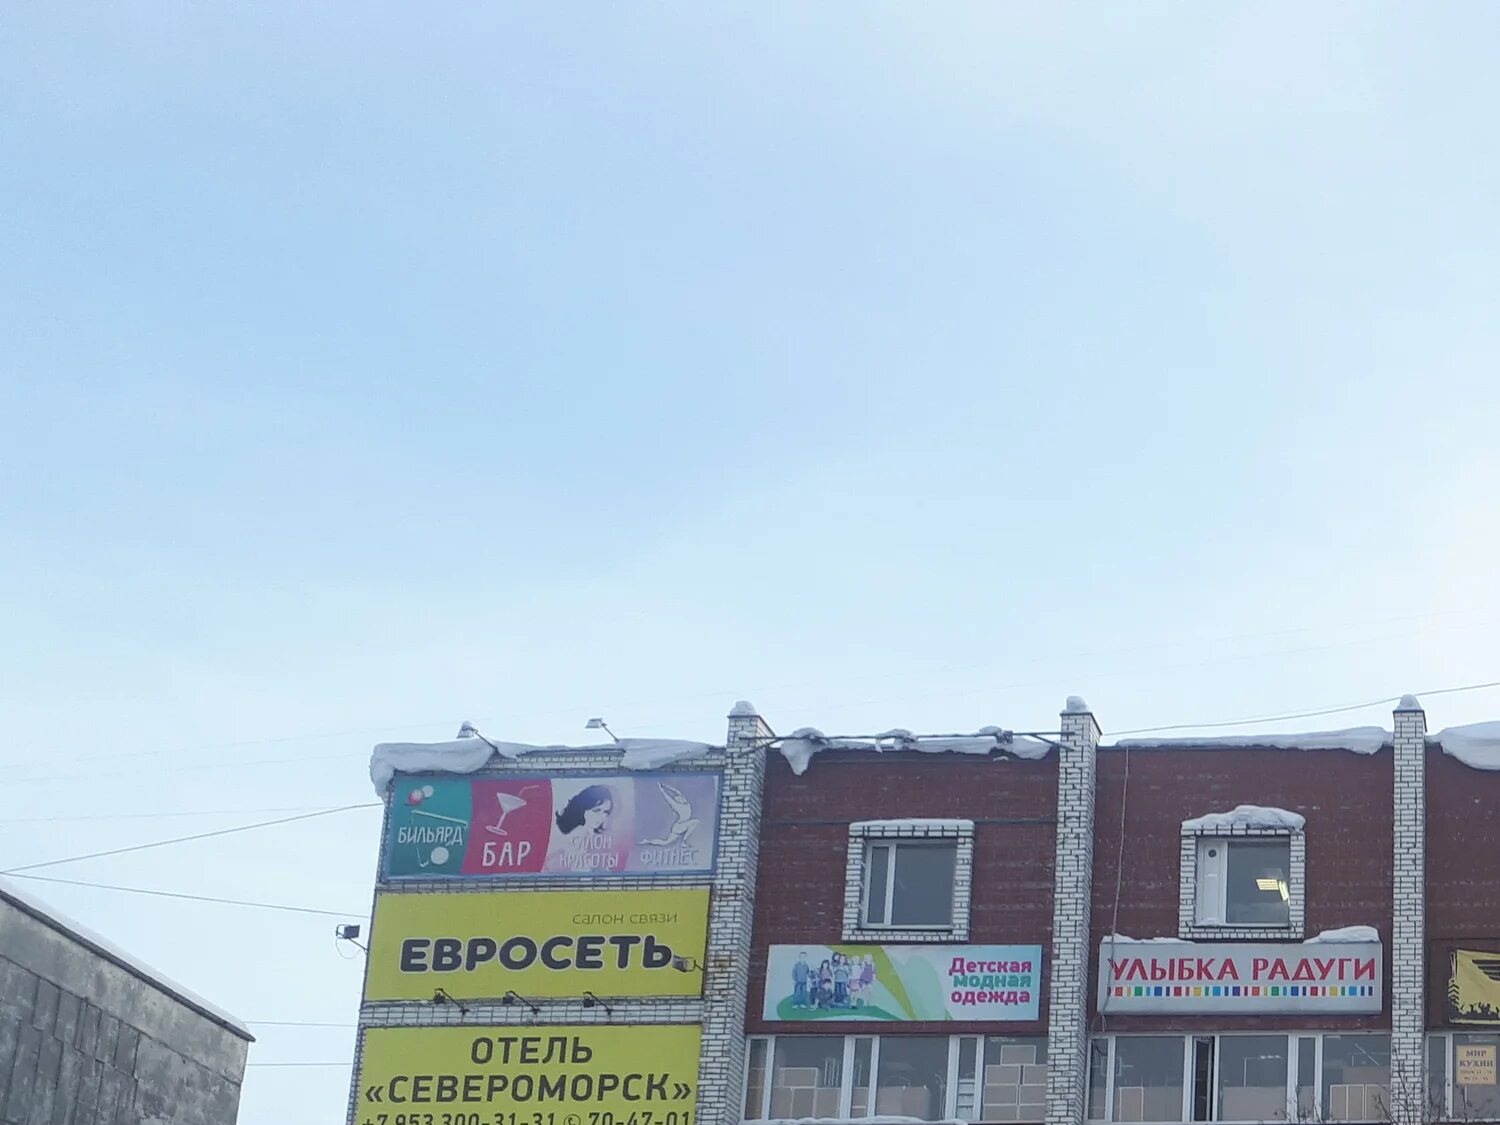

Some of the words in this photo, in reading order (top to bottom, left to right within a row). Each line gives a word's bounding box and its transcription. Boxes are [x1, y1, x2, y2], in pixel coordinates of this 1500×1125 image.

[397, 826, 463, 846] БИЛЬЯРД
[482, 841, 532, 867] БАР
[560, 852, 619, 869] КРАСОТЫ
[642, 849, 700, 867] ФИТНЕС
[572, 913, 625, 926] салон
[629, 912, 678, 925] связи
[400, 934, 674, 972] ЕВРОСЕТЬ
[948, 956, 1033, 976] Детская
[1107, 957, 1240, 981] УЛЫБКА
[1252, 957, 1376, 981] РАДУГИ
[953, 974, 1032, 989] модная
[950, 989, 1031, 1005] одежда
[470, 1036, 594, 1065] ОТЕЛЬ
[364, 1073, 692, 1104] «СЕВЕРОМОРСК»
